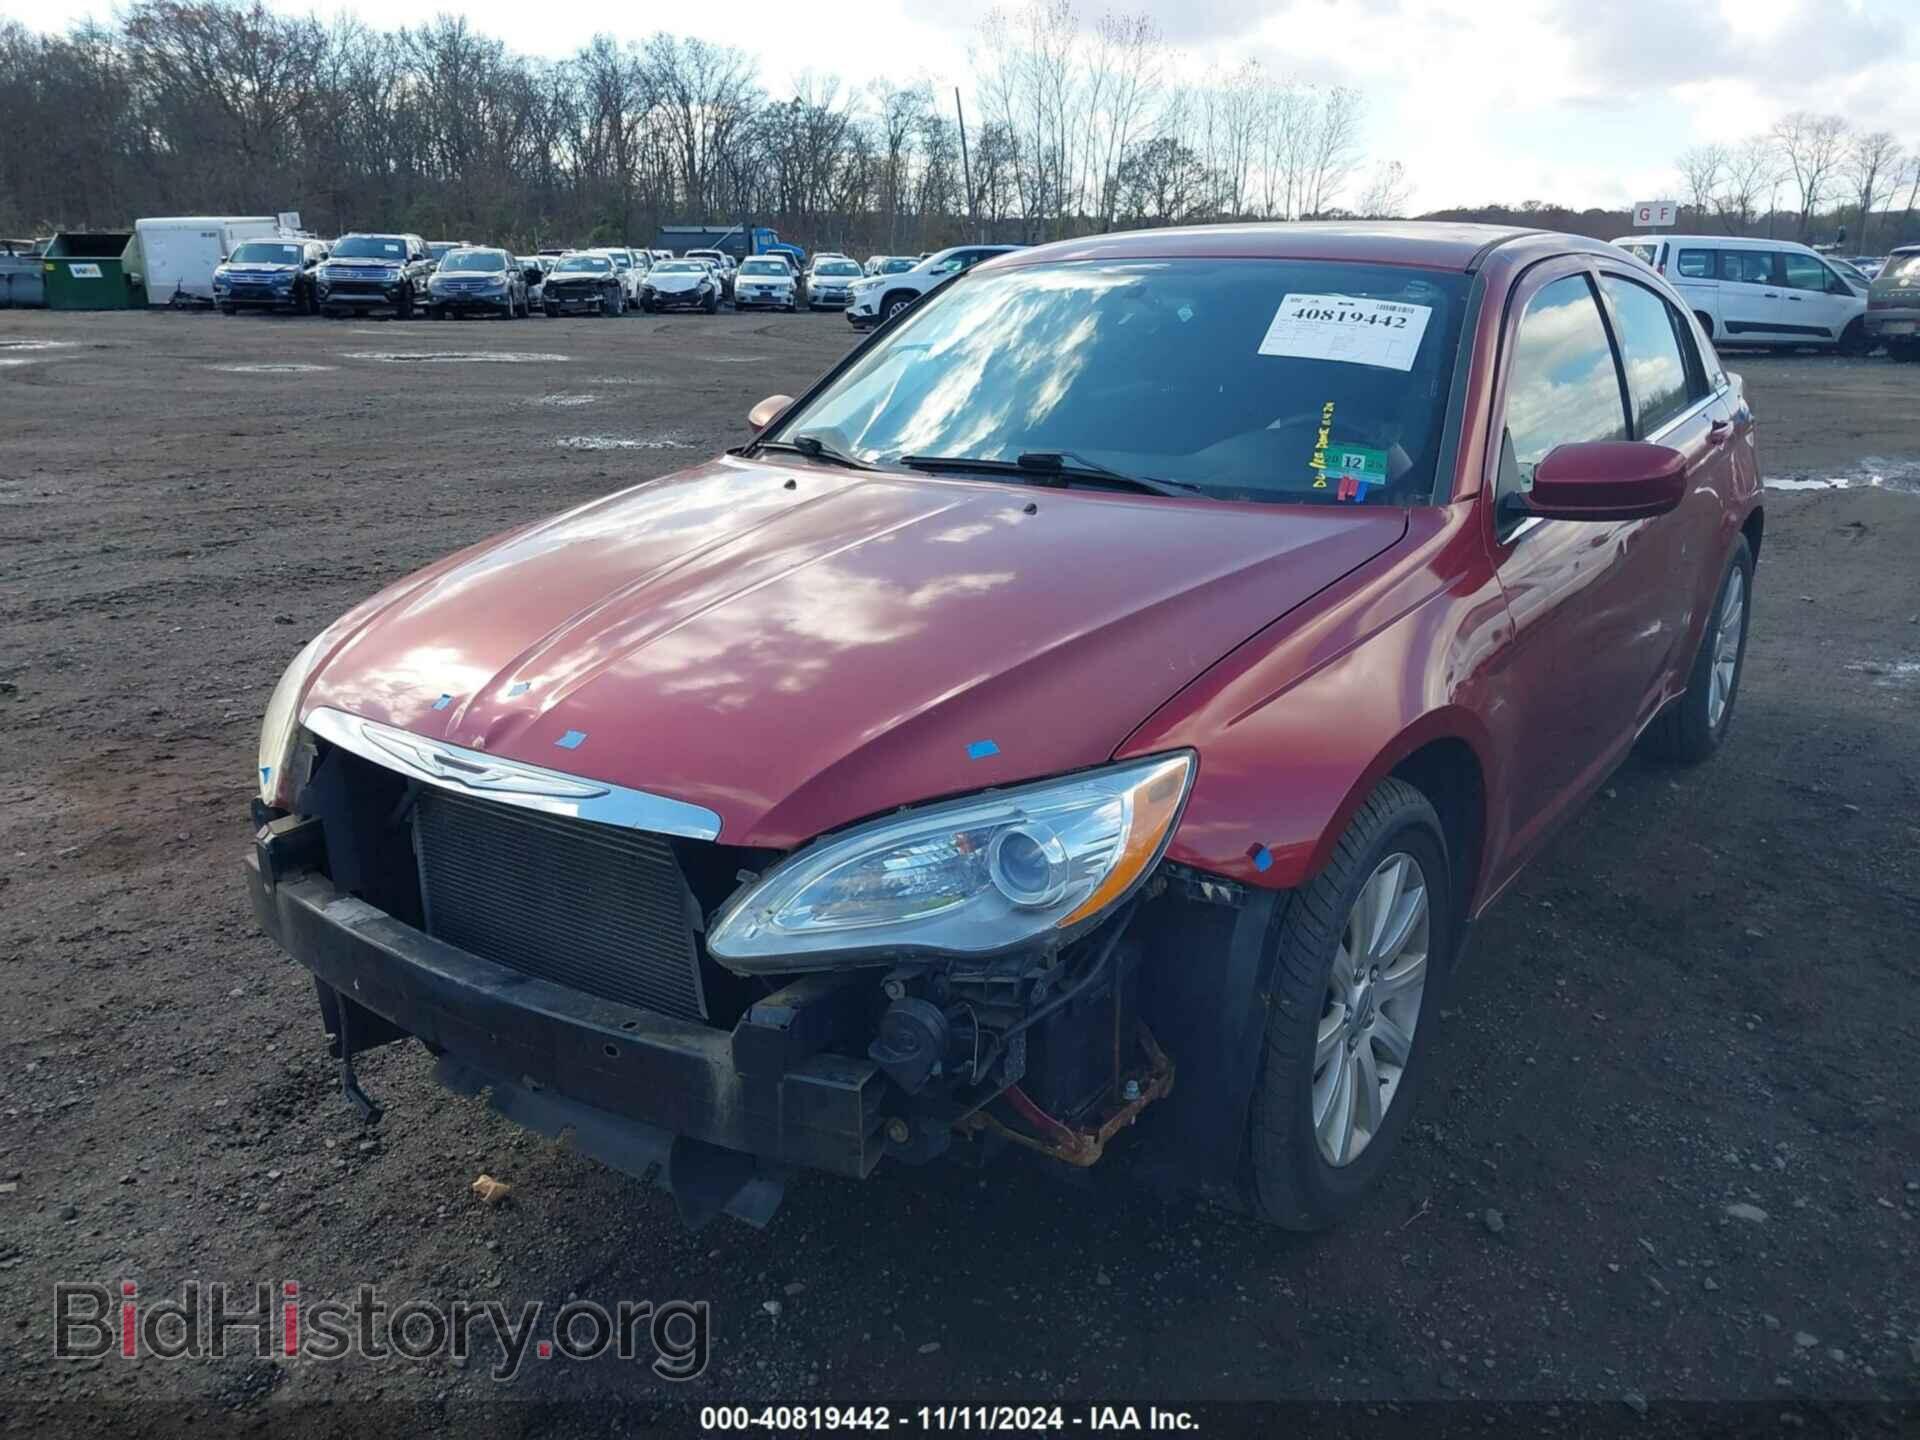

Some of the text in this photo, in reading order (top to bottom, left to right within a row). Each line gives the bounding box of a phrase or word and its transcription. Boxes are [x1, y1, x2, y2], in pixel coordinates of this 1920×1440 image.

[1640, 207, 1669, 220] G F
[1291, 307, 1407, 329] 40819442
[1344, 456, 1362, 469] 12
